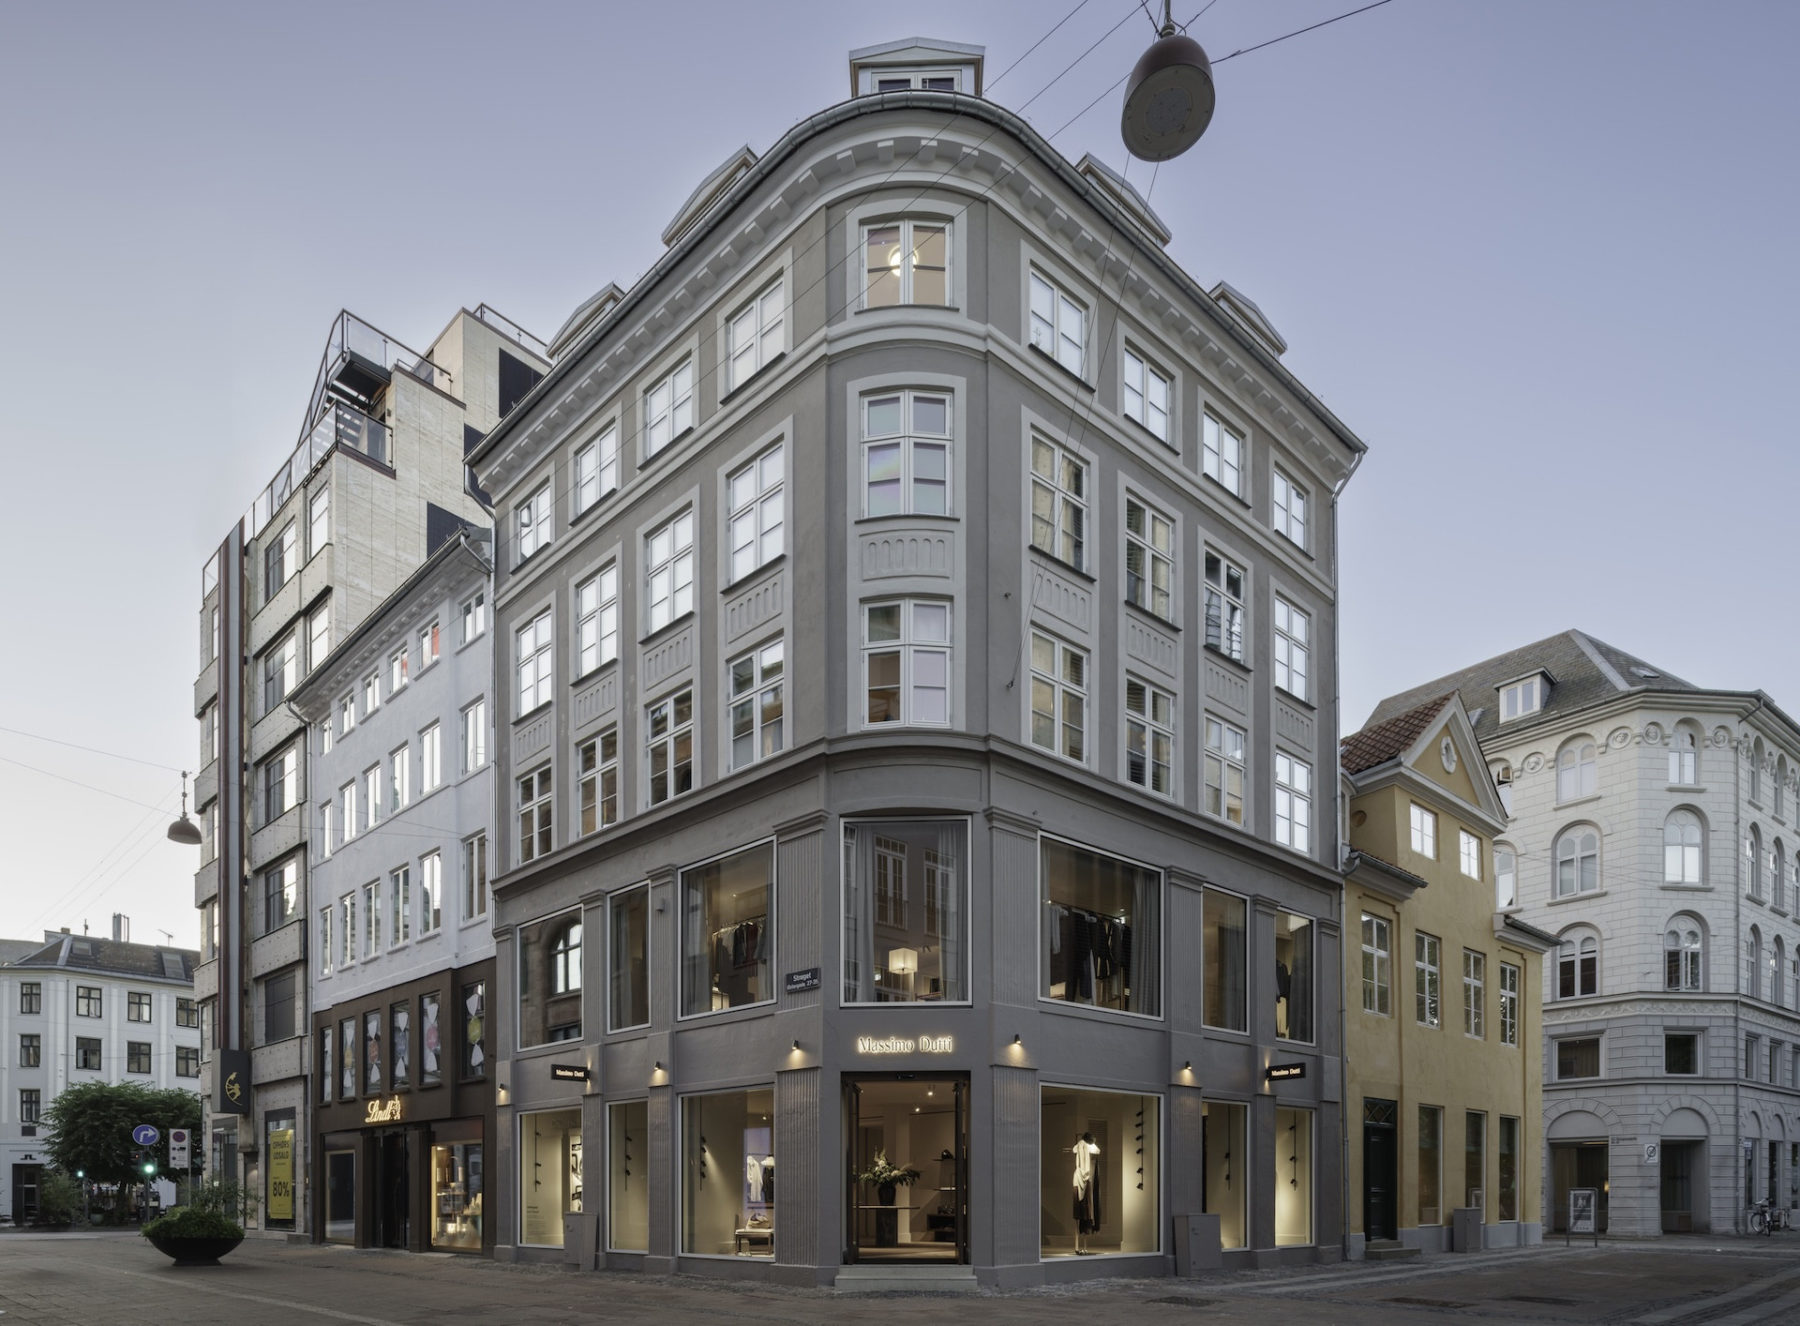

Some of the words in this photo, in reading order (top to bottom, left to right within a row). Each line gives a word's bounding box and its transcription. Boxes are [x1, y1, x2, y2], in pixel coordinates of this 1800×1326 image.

[858, 1036, 915, 1053] Massimo
[919, 1036, 953, 1053] Dutti
[556, 1069, 573, 1077] Massimo
[574, 1070, 585, 1078] Dutti
[1271, 1069, 1289, 1077] Massimo
[1290, 1067, 1301, 1075] Dutti
[273, 1181, 290, 1198] 80%
